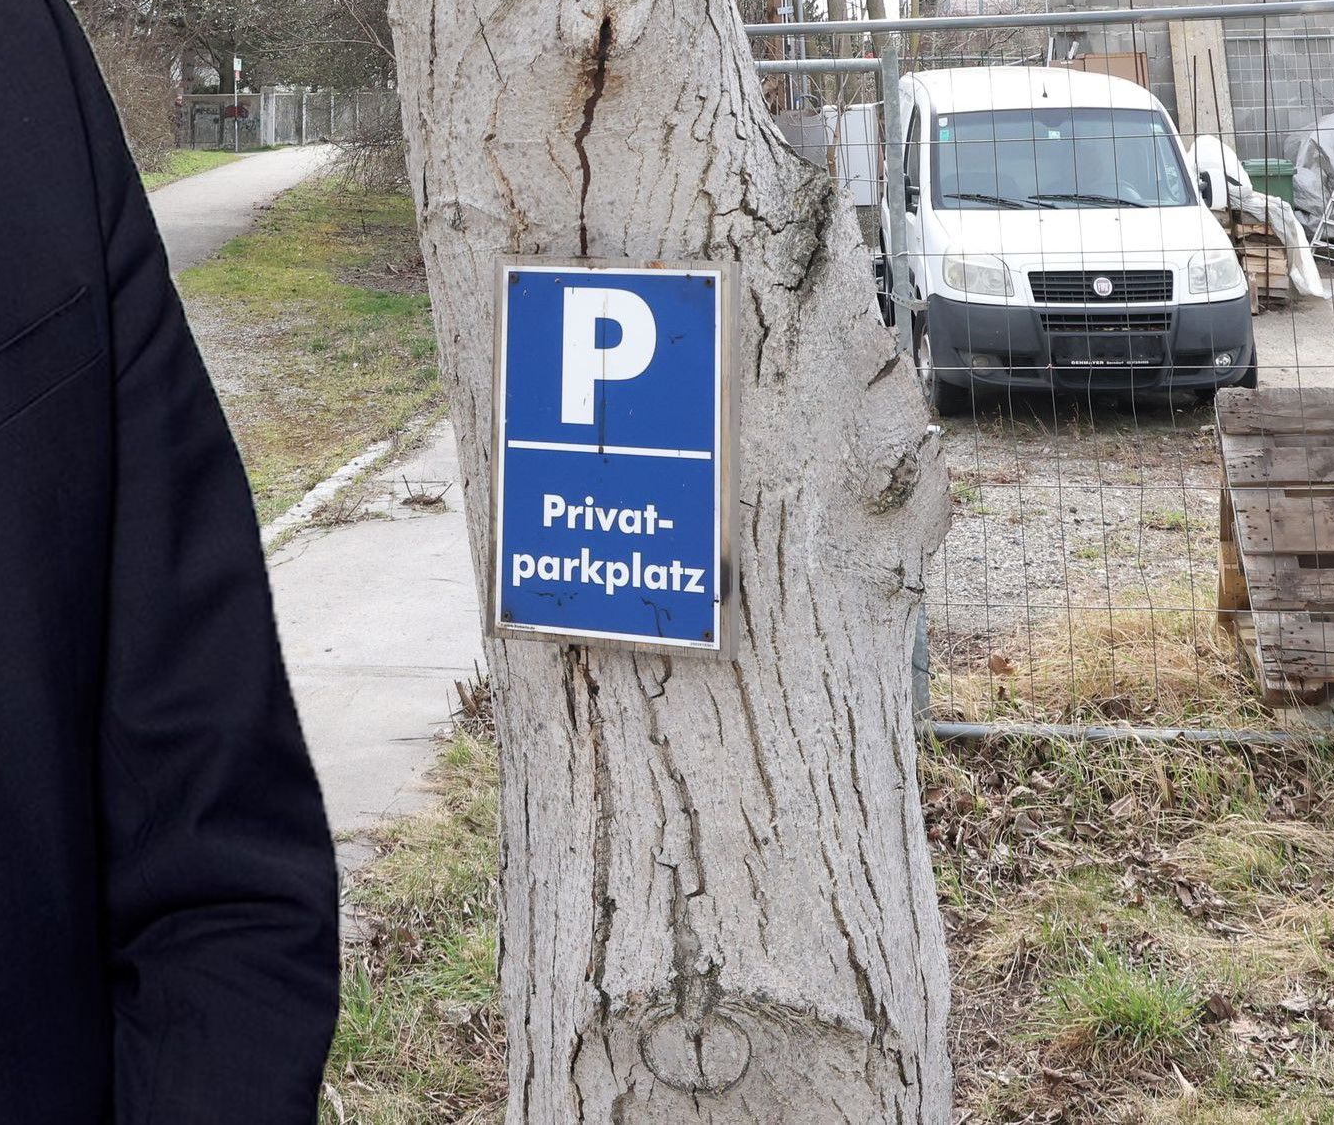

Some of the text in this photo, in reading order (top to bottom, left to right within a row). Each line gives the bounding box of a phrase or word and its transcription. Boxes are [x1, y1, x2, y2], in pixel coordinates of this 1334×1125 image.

[560, 286, 657, 425] P
[543, 493, 674, 535] Privat-
[512, 547, 706, 596] parkplatz
